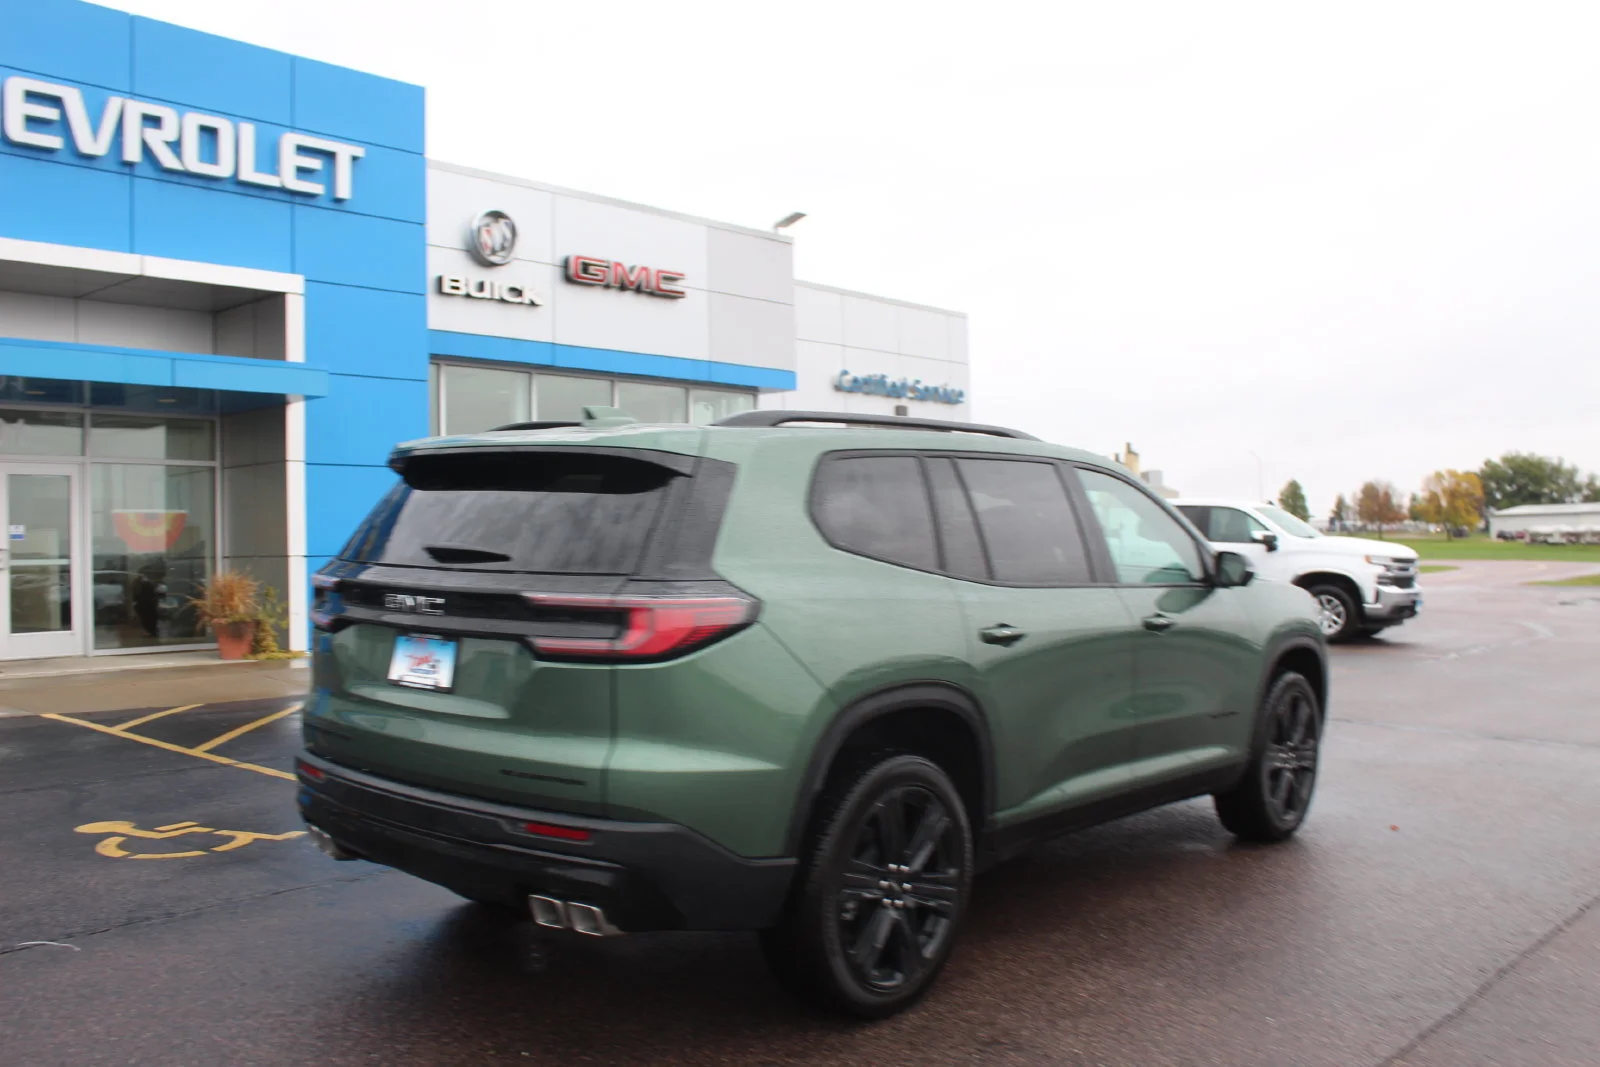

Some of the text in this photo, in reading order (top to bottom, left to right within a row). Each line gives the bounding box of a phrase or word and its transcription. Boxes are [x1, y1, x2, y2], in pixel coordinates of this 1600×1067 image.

[3, 75, 366, 201] EVROLET
[439, 274, 543, 306] BUICK
[566, 254, 687, 298] GMC
[384, 593, 446, 616] GMC
